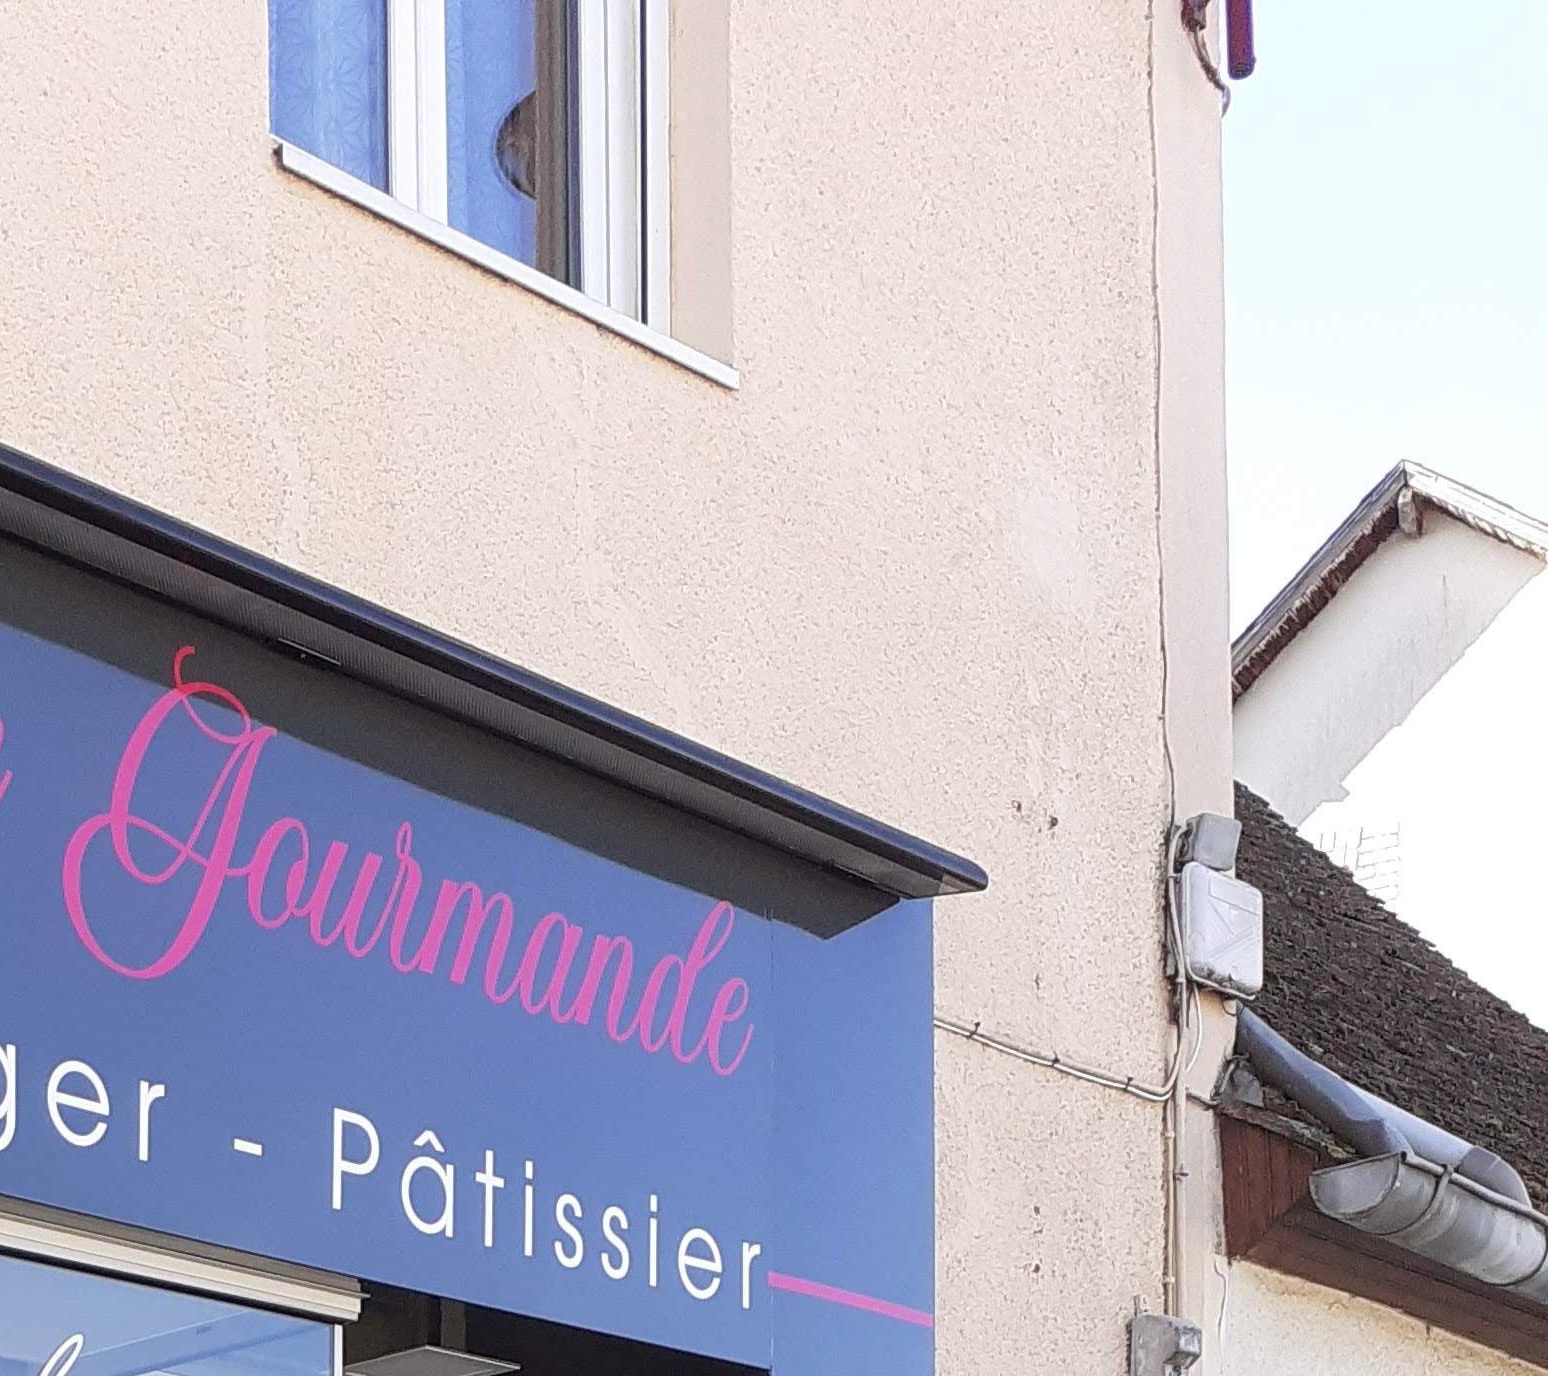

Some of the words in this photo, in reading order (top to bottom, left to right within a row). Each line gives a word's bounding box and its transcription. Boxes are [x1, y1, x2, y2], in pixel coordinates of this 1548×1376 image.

[62, 647, 755, 1076] Gourmande
[234, 1137, 263, 1157] -
[332, 1108, 762, 1310] Pâtissier
